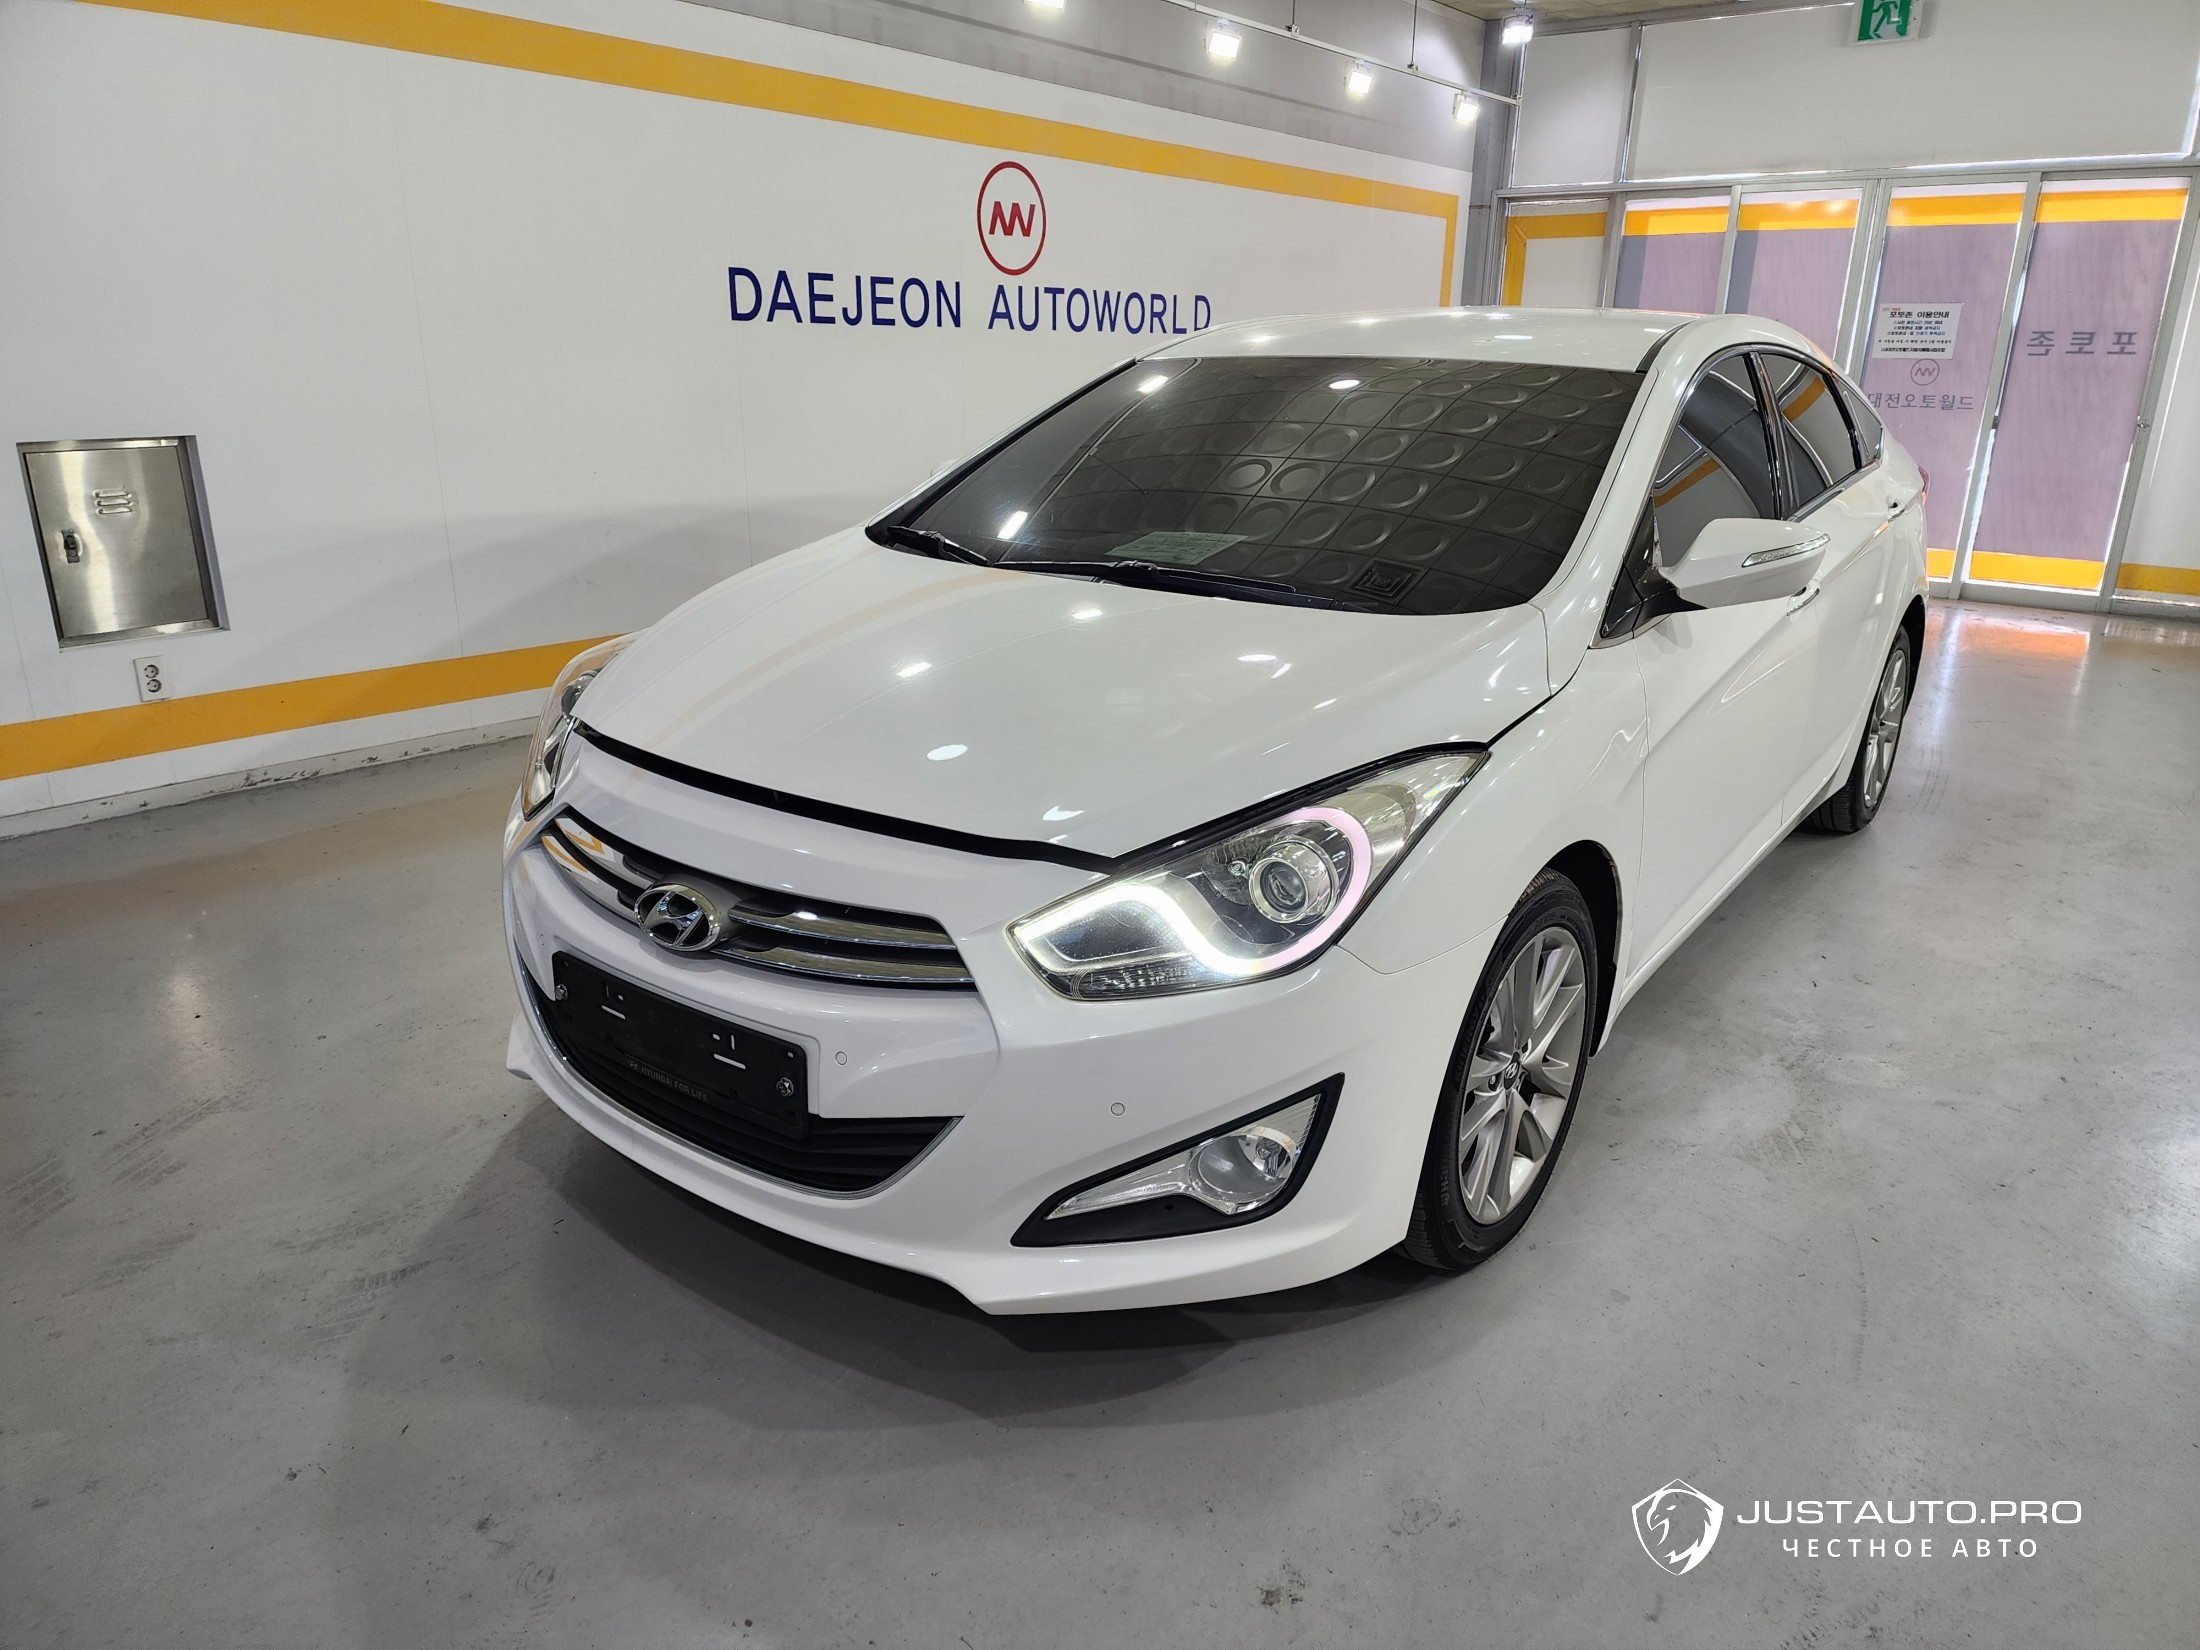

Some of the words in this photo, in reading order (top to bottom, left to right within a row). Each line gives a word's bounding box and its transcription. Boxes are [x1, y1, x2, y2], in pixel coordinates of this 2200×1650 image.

[727, 266, 961, 328] DAEJEON
[988, 284, 1211, 335] AUTOWORLD
[1916, 311, 1950, 319] 이용안내
[1867, 392, 1974, 411] 대전오토월드
[641, 1064, 673, 1087] HYUNDAI
[674, 1080, 690, 1095] FOR
[691, 1087, 708, 1102] LIFE
